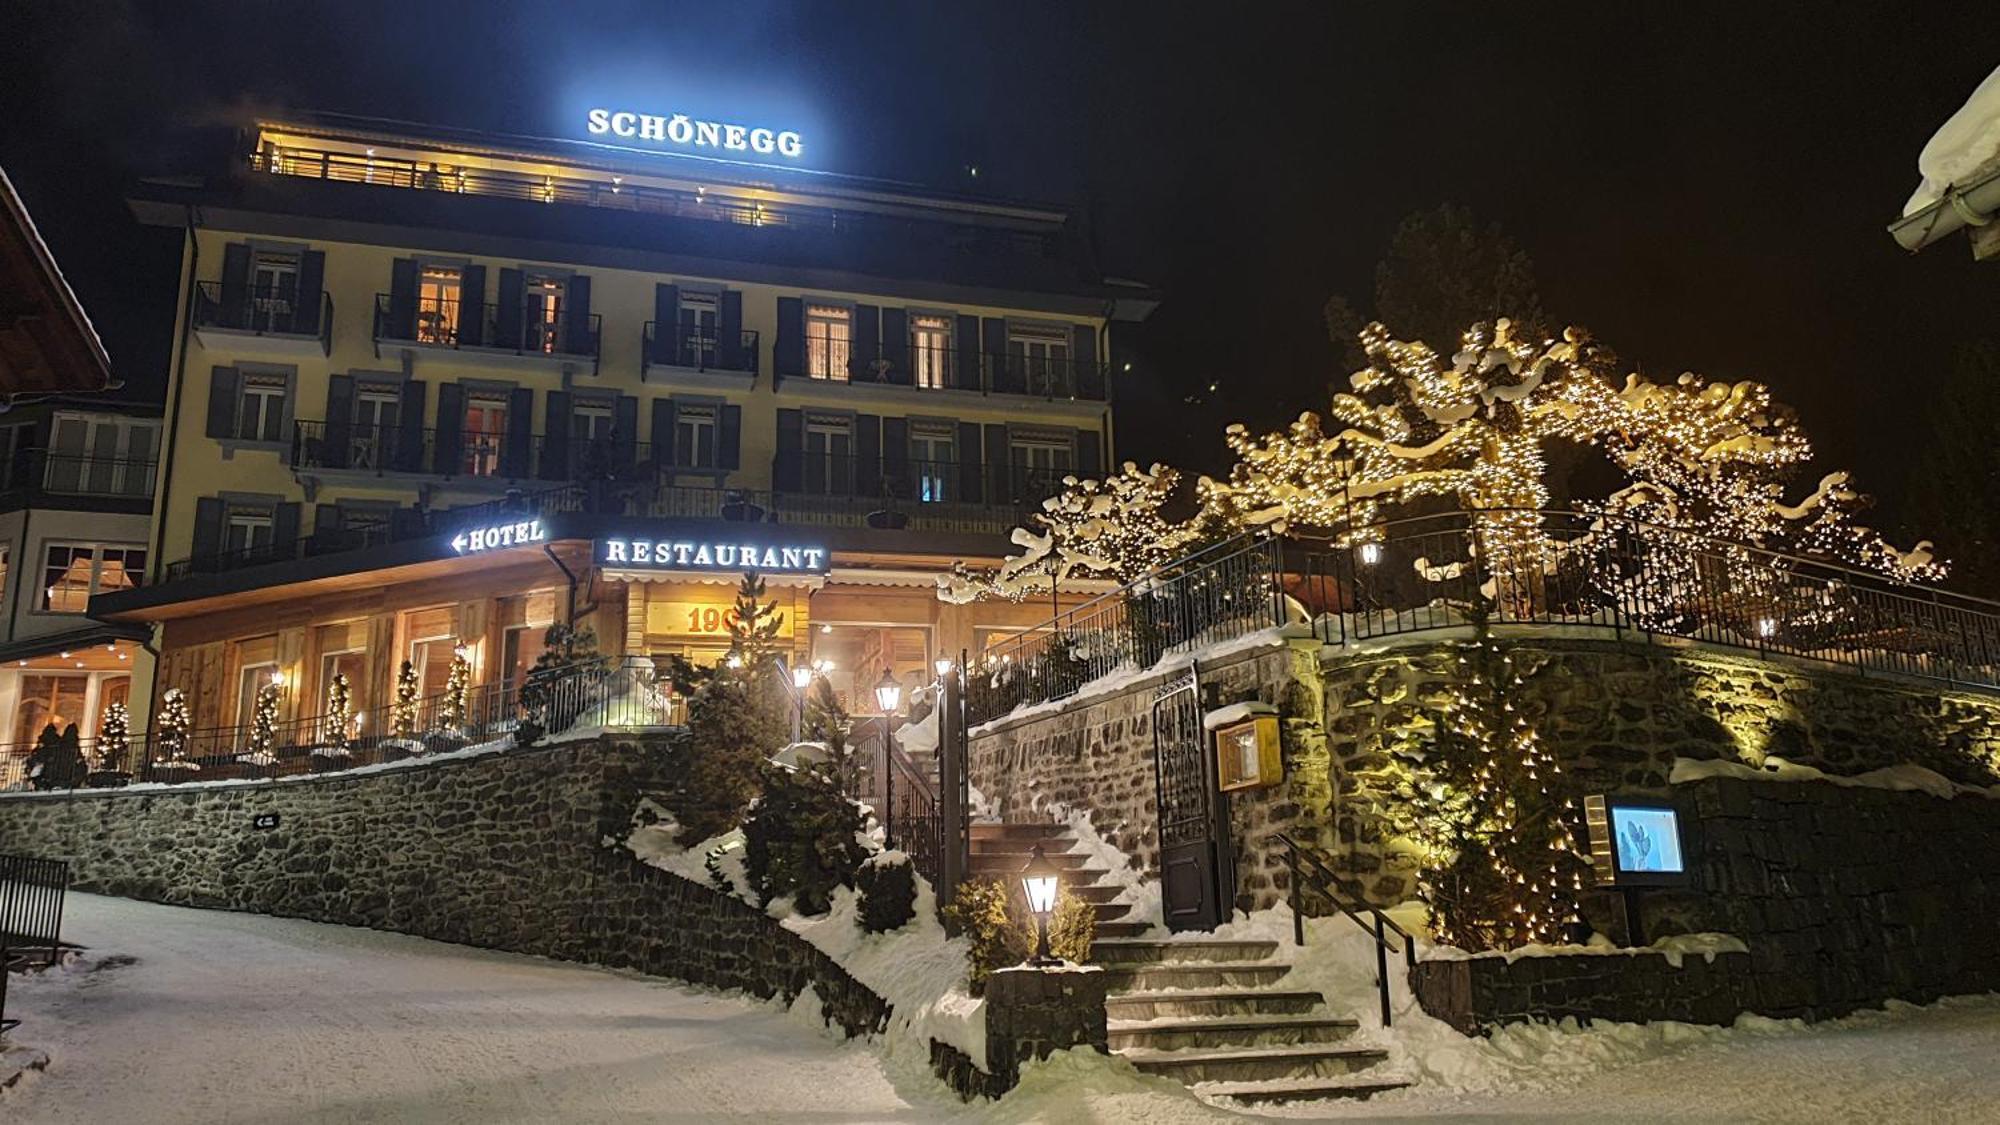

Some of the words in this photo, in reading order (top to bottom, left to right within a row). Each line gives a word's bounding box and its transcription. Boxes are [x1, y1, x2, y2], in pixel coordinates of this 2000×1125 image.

[588, 108, 803, 158] SCHÖNEGG
[468, 520, 545, 552] HOTEL
[605, 539, 824, 570] RESTAURANT
